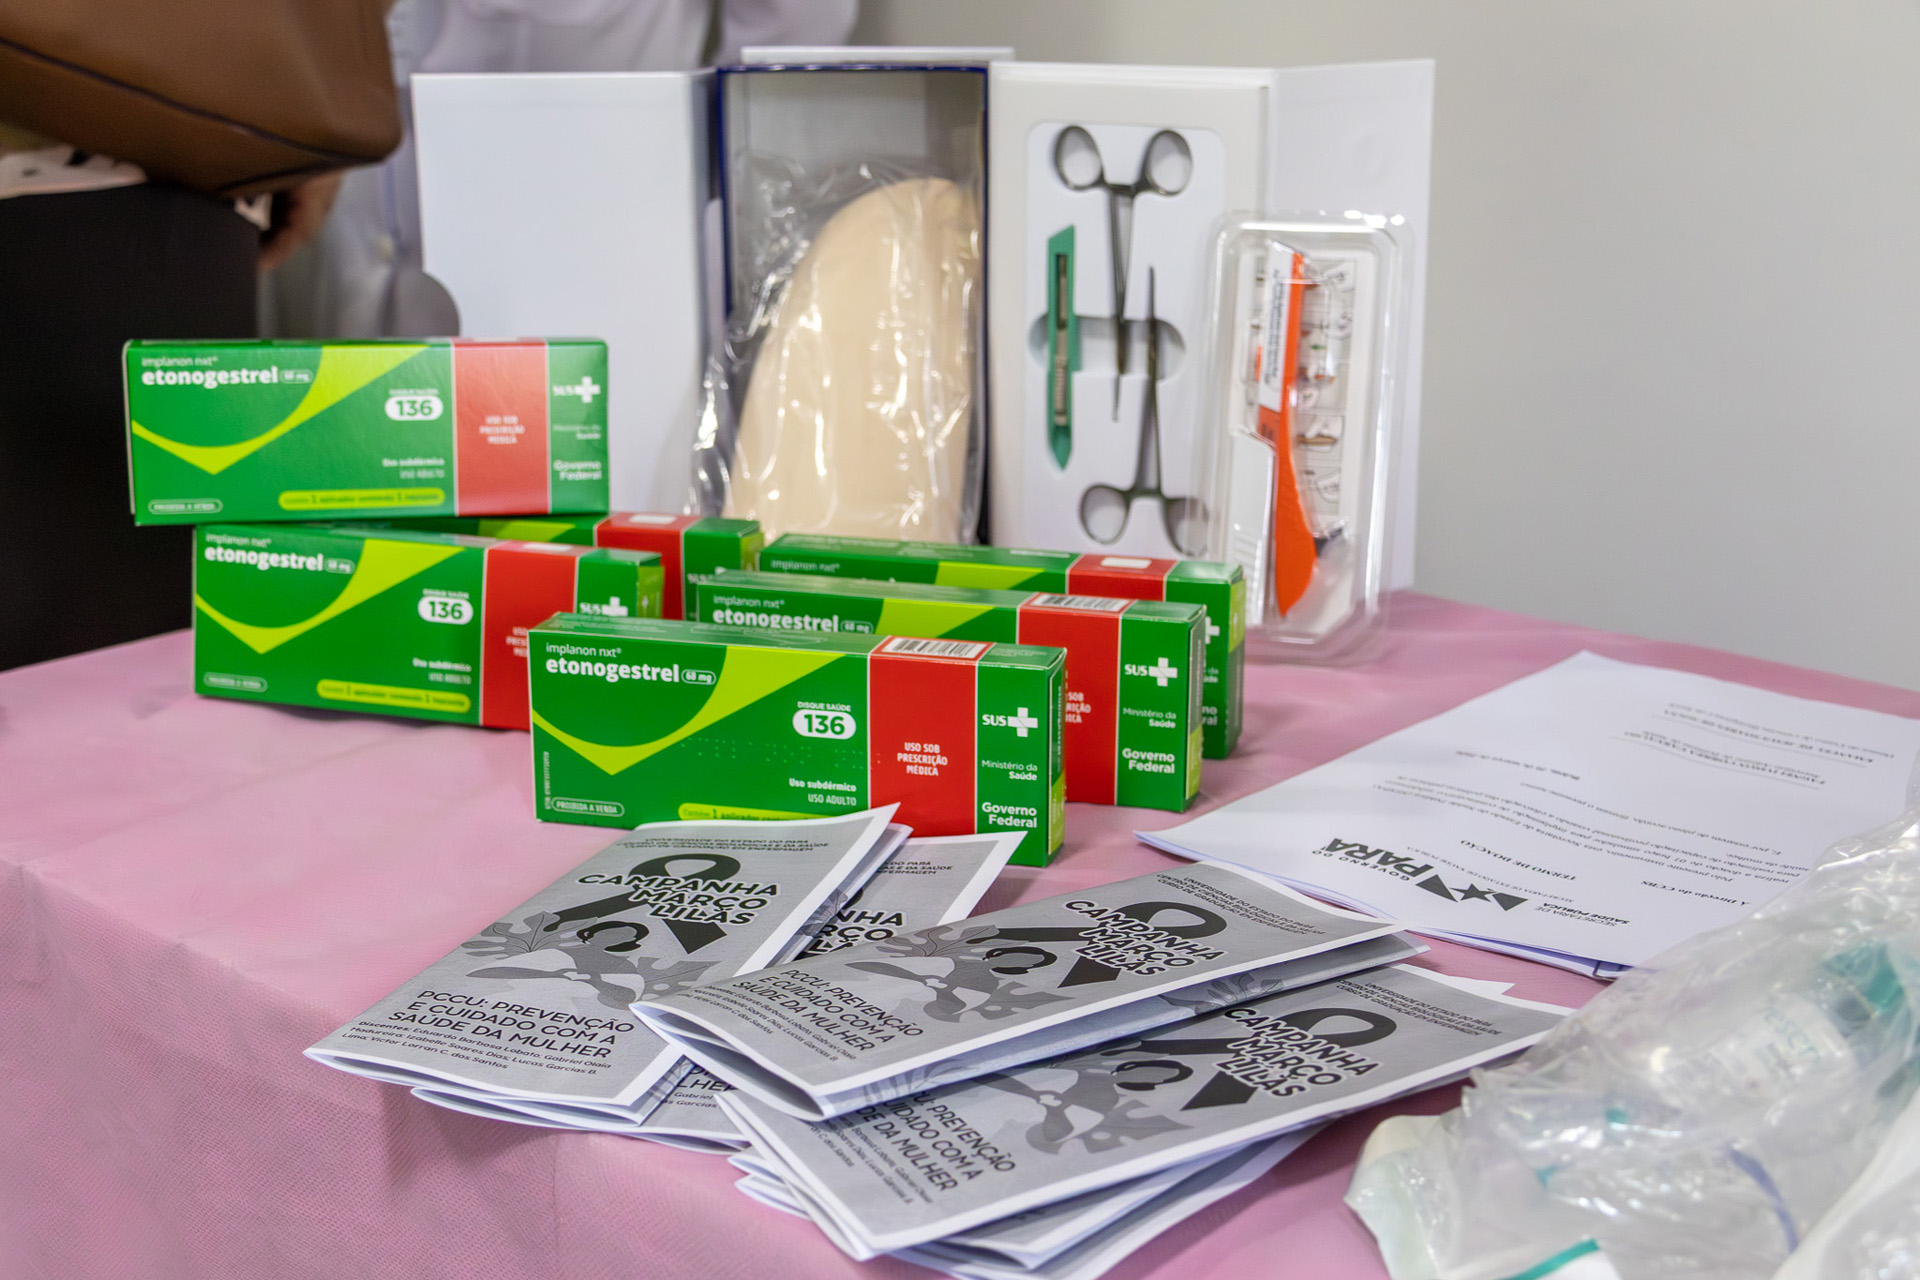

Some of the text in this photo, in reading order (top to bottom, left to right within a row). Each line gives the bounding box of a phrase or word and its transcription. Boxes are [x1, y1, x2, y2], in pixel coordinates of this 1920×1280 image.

[141, 365, 278, 389] etonogestrel
[397, 400, 433, 417] 136
[204, 546, 323, 571] etonogestrel
[429, 601, 463, 620] 136
[713, 594, 761, 608] implanon
[713, 608, 838, 632] etonogestrel
[546, 643, 597, 657] implanon
[546, 657, 712, 684] etonogestrel 68 mg
[1124, 663, 1148, 677] SUS
[797, 701, 851, 712] DISQUE SAÚDE
[804, 713, 845, 735] 136
[982, 714, 1007, 727] SUS
[1149, 719, 1176, 729] Saúde
[904, 742, 940, 754] USO SOB
[1122, 748, 1175, 763] Governo
[897, 752, 947, 767] PRESCRIÇÃO
[906, 764, 939, 776] MÉDICA
[982, 759, 1038, 772] Ministério da
[1129, 759, 1175, 774] Federal
[789, 777, 856, 792] Uso subdérmico
[1009, 770, 1037, 781] Saúde
[808, 794, 856, 806] USO ADULTO
[982, 801, 1037, 816] Governo
[988, 814, 1037, 828] Federal
[1312, 849, 1410, 882] GOVERNO DO
[1320, 837, 1434, 878] PARÁ
[1512, 861, 1531, 869] DE
[577, 872, 778, 896] CAMPANHA
[1532, 866, 1576, 880] TERMO
[633, 889, 768, 911] MARÇO
[650, 903, 752, 924] LILÁS
[1543, 903, 1630, 925] SAÚDE PÚBLICA
[1552, 910, 1617, 927] SECRETARIA
[816, 924, 894, 943] RÇO
[1065, 900, 1224, 961] CAMPANHA
[1090, 927, 1195, 968] MARÇO
[1075, 944, 1166, 977] LILÁS
[417, 990, 635, 1033] PCCU: PREVENÇÃO
[776, 981, 844, 1013] CUIDADO
[839, 1013, 884, 1035] COM
[875, 1033, 896, 1043] A
[779, 968, 924, 1037] PCCU: PREVENÇÃO
[407, 1001, 616, 1045] E CUIDADO COM A
[733, 980, 876, 1051] SAÚDE DA MULHER
[358, 1021, 412, 1032] Discentes:
[413, 1028, 457, 1039] Eduardo
[459, 1036, 502, 1050] Barbosa
[544, 1054, 582, 1065] Gabriel
[389, 1012, 612, 1059] SAÚDE DA MULHER
[1225, 1007, 1379, 1077] CAMPANHA
[371, 1036, 402, 1045] Victor
[402, 1041, 438, 1053] Lorran
[451, 1052, 470, 1061] dos
[472, 1057, 509, 1069] Santos
[406, 1034, 447, 1047] Izabelle
[449, 1042, 485, 1055] Soares
[512, 1057, 544, 1067] Lucas
[546, 1063, 585, 1074] Garcias
[1233, 1039, 1342, 1085] MARÇO
[1216, 1058, 1307, 1097] LILÁS
[674, 1092, 714, 1100] Gabriel
[676, 1100, 718, 1108] Garcias
[883, 1100, 940, 1139] UIDADO
[932, 1139, 975, 1170] COM
[962, 1168, 984, 1181] A
[926, 1104, 1016, 1172] PREVENÇÃO
[874, 1121, 902, 1140] DA
[893, 1138, 958, 1192] MULHER
